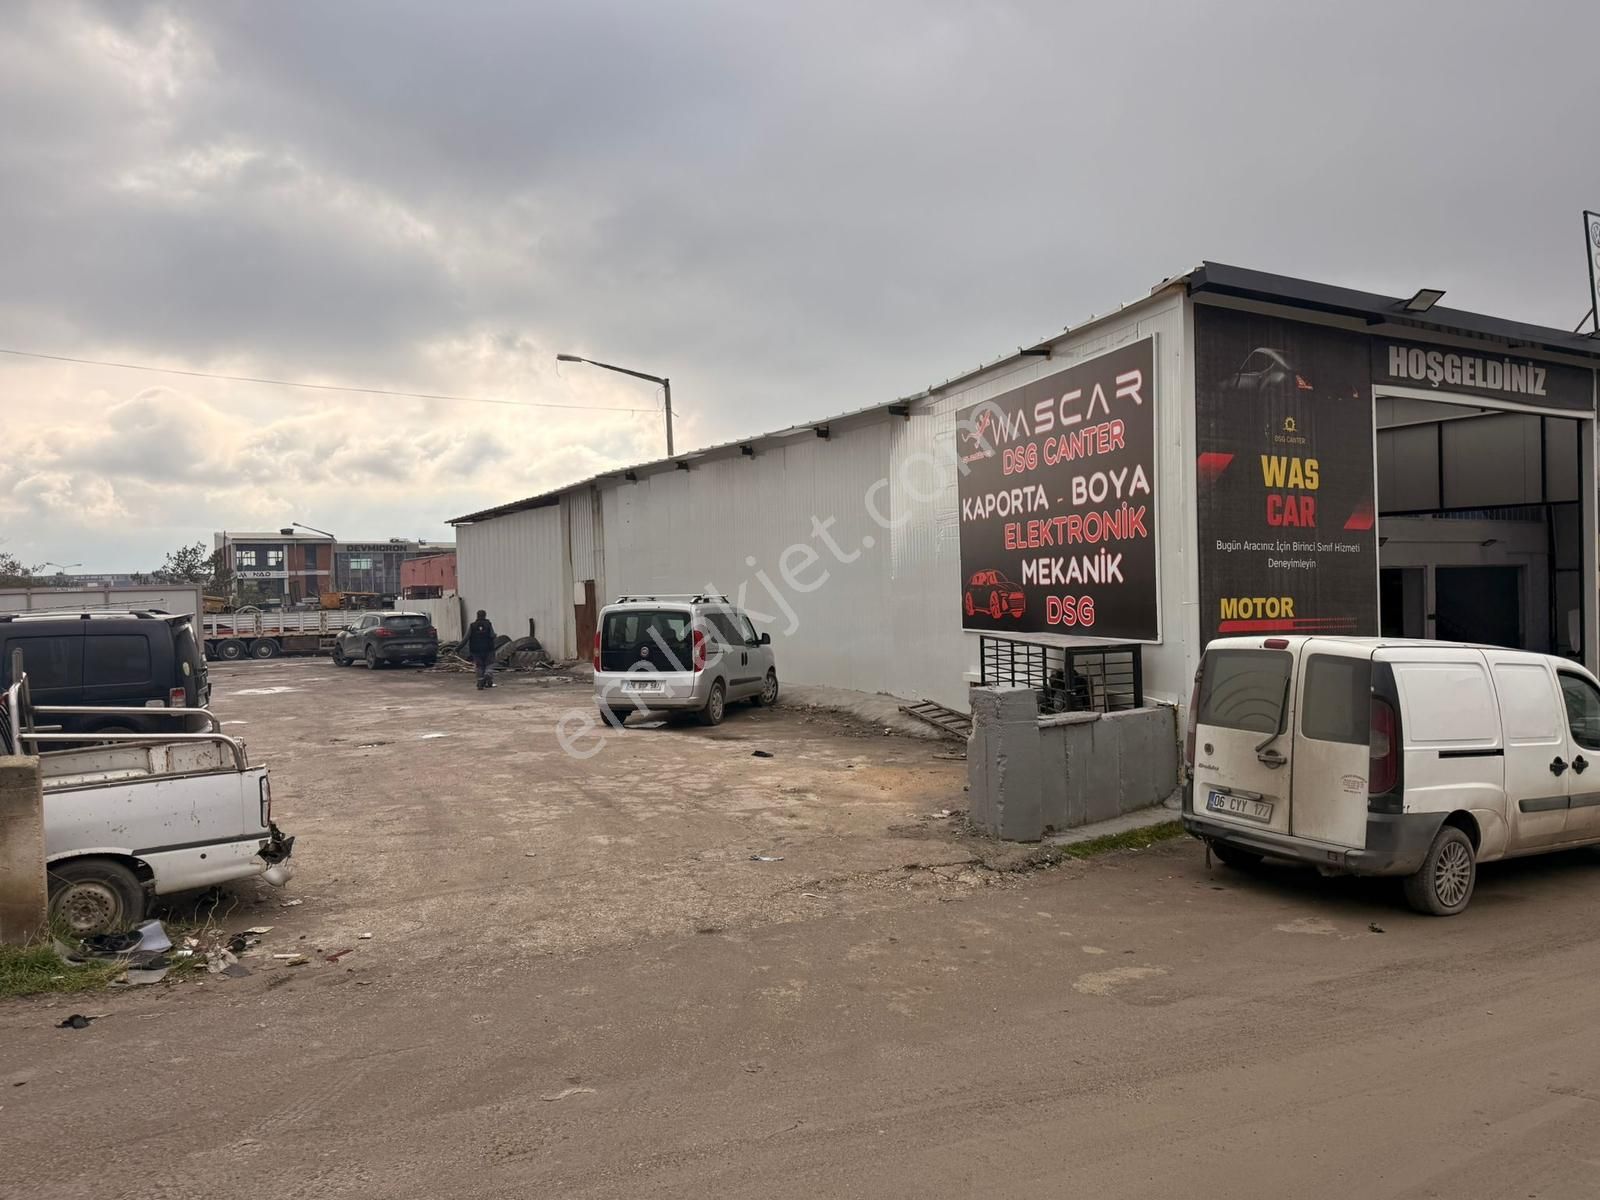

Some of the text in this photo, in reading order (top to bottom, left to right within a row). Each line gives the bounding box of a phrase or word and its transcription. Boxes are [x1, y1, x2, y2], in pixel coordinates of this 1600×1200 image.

[1388, 345, 1547, 396] HOŞGELDİNİZ
[1002, 419, 1126, 475] DSG CANTER
[1261, 454, 1320, 490] WAS
[962, 483, 1050, 522] KAPORTA
[1071, 464, 1150, 506] BOYA
[1004, 501, 1148, 551] ELEKTRONİK
[1266, 494, 1316, 528] CAR
[1216, 539, 1241, 553] Bugün
[1243, 540, 1275, 551] Aracınız
[1276, 539, 1291, 553] İçin
[1292, 541, 1315, 552] Birinci
[1334, 542, 1360, 553] Hizmeti
[1268, 557, 1317, 570] Deneyimleyin
[1021, 547, 1124, 585] MEKANİK
[1046, 595, 1095, 627] DSG
[1220, 596, 1295, 619] MOTOR
[1214, 795, 1225, 808] 06
[1230, 798, 1248, 812] CYY
